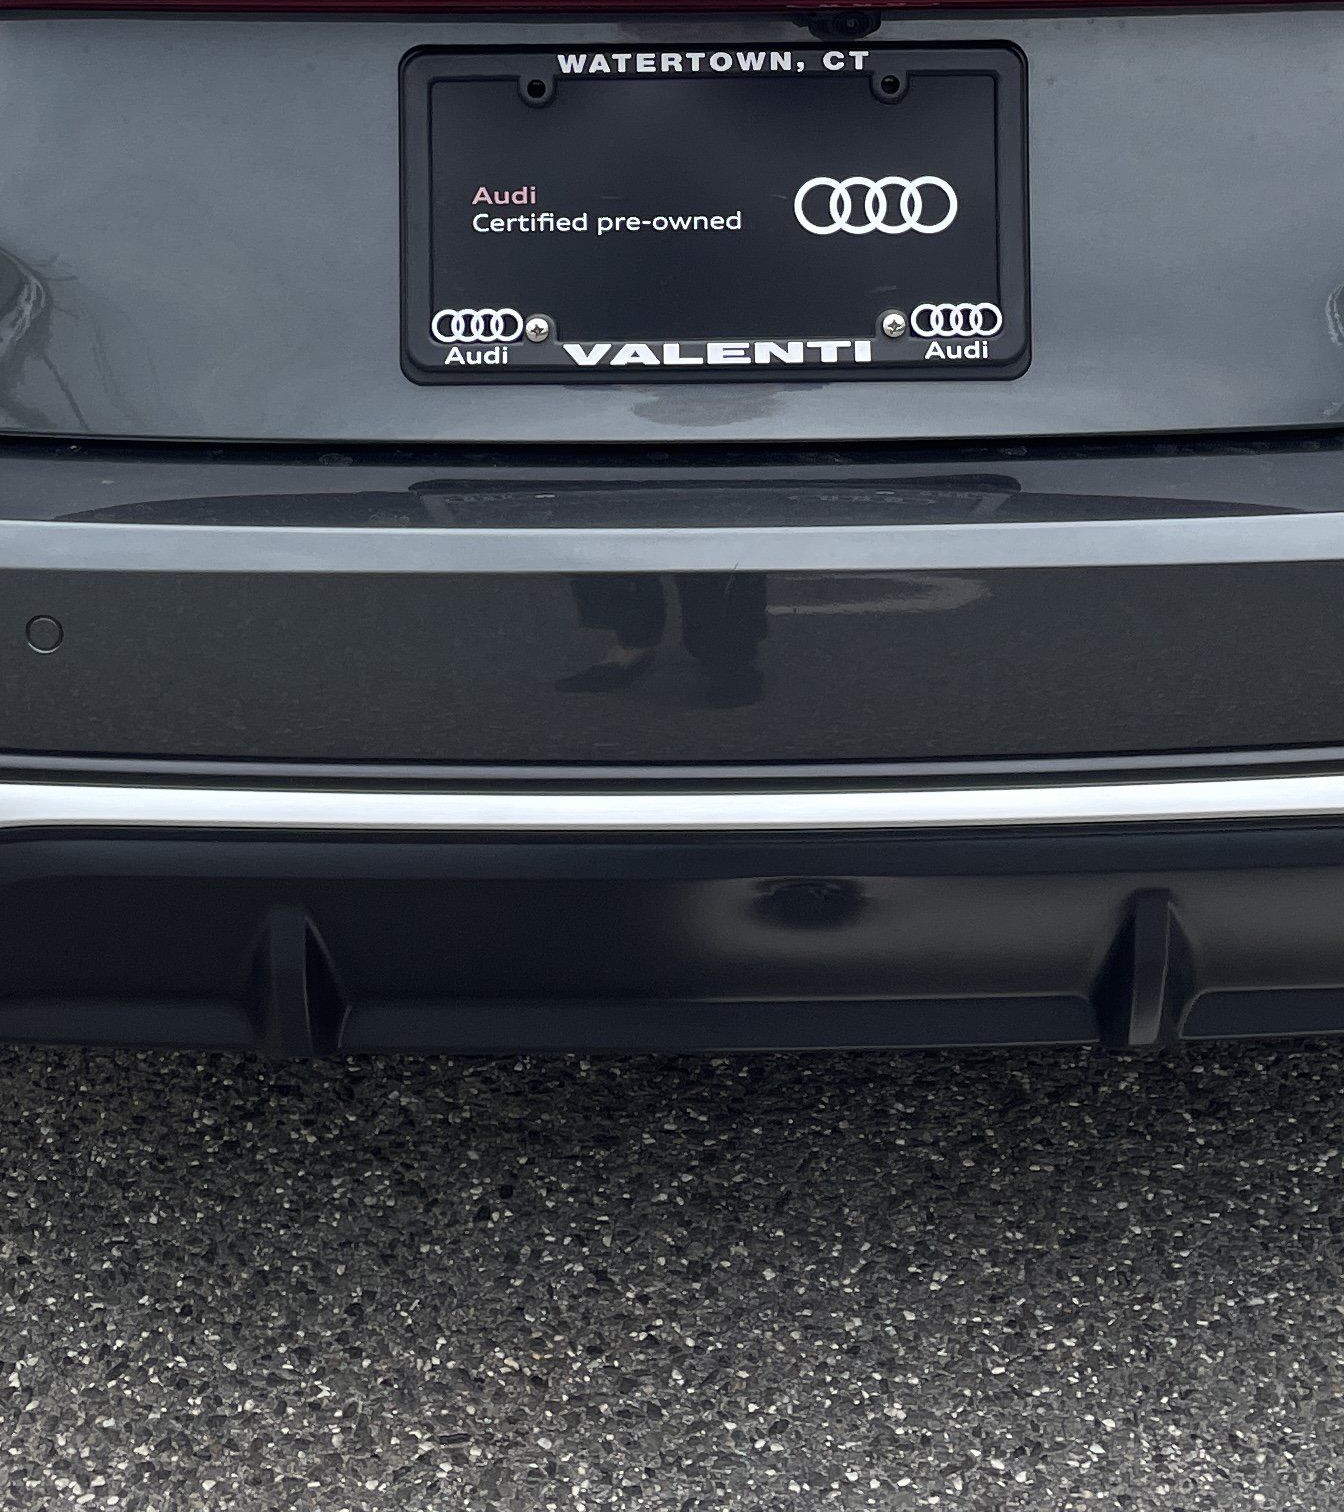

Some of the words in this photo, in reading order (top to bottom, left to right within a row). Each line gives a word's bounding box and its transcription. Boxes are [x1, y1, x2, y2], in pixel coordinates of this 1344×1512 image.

[557, 51, 805, 74] WATERTOWN,
[822, 50, 870, 71] CT
[471, 185, 537, 205] Audi
[471, 211, 588, 233] Certified
[597, 210, 743, 236] pre-owned
[444, 345, 510, 366] Audi
[562, 340, 873, 367] VALENTI
[923, 338, 990, 360] Audi
